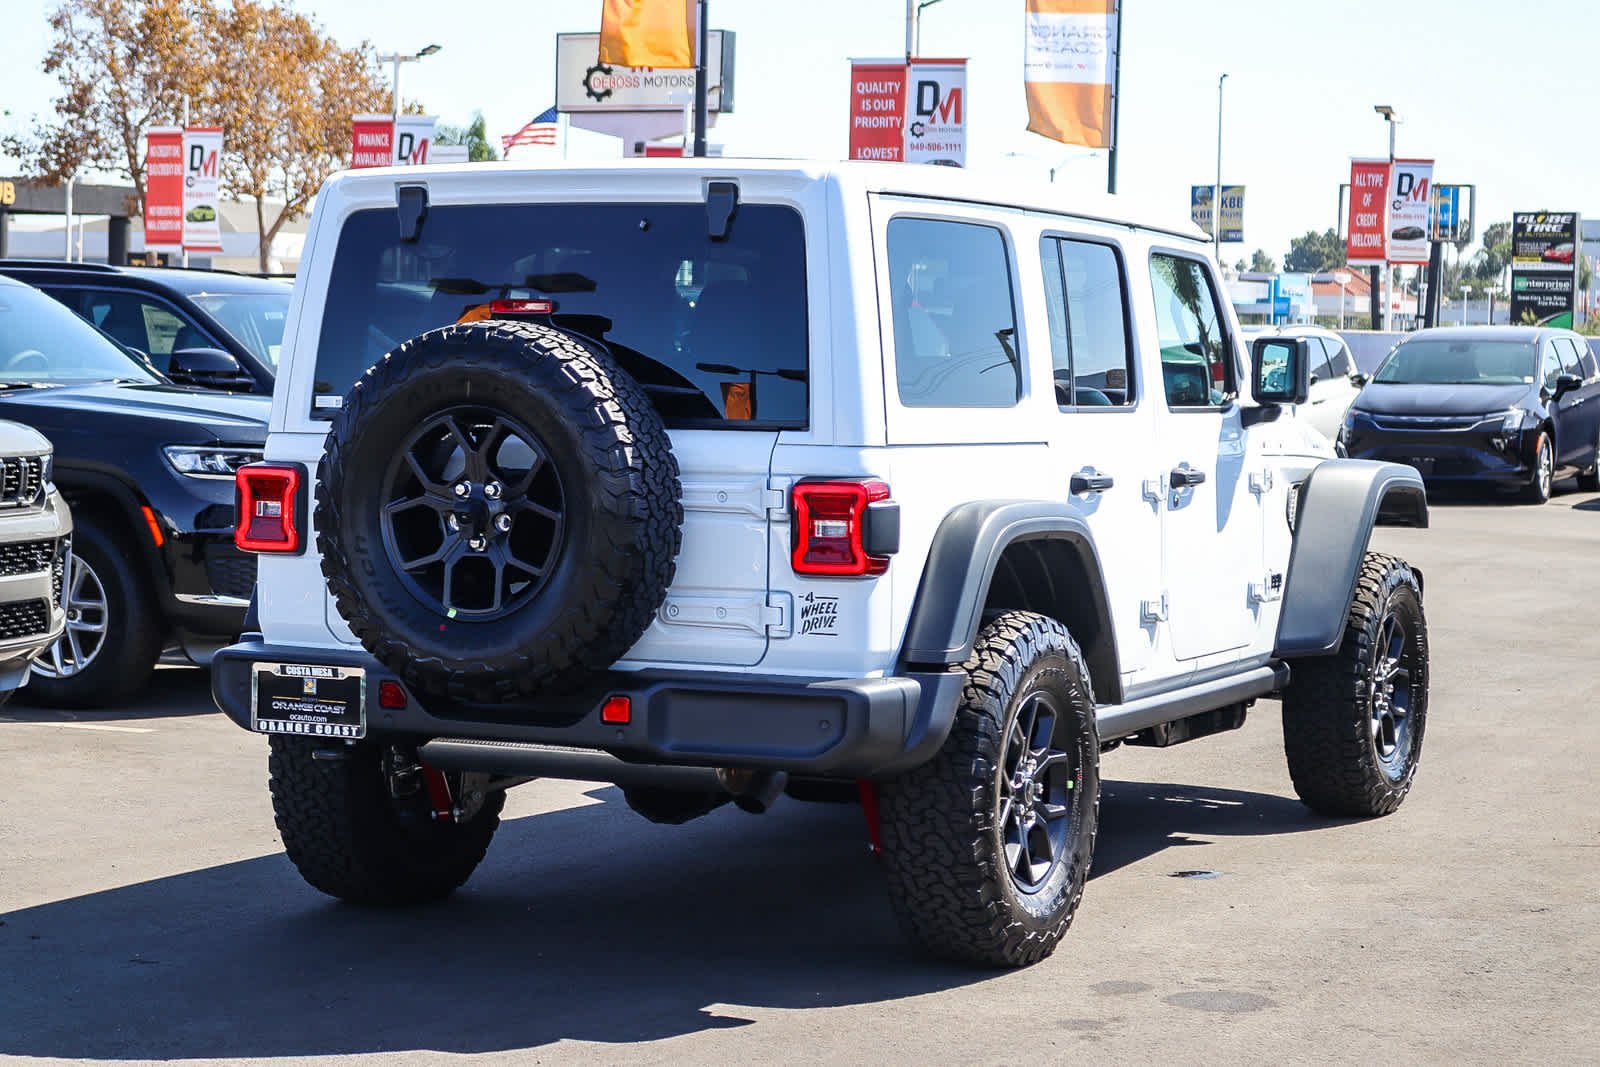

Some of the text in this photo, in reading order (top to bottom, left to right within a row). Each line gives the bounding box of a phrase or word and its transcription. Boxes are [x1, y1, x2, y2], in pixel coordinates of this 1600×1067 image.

[592, 75, 695, 89] DEBOSS MOTORS
[857, 81, 901, 95] QUALITY
[862, 99, 895, 111] IS OUR
[855, 116, 902, 128] PRIORITY
[358, 133, 389, 147] FINANCE
[858, 147, 900, 159] LOWEST
[1355, 173, 1384, 187] ALL TYPE
[1362, 193, 1372, 207] OF
[1356, 213, 1377, 227] CREDIT
[1525, 223, 1564, 233] TIRE
[1351, 233, 1382, 247] WELCOME
[805, 591, 814, 603] 4
[801, 602, 838, 619] WHEEL
[801, 615, 837, 635] DRIVE
[285, 666, 333, 677] COSTA MESA
[271, 701, 346, 714] ORANGE COAST
[289, 714, 328, 723] ocauto.com
[260, 720, 359, 736] ORANGE COAST
